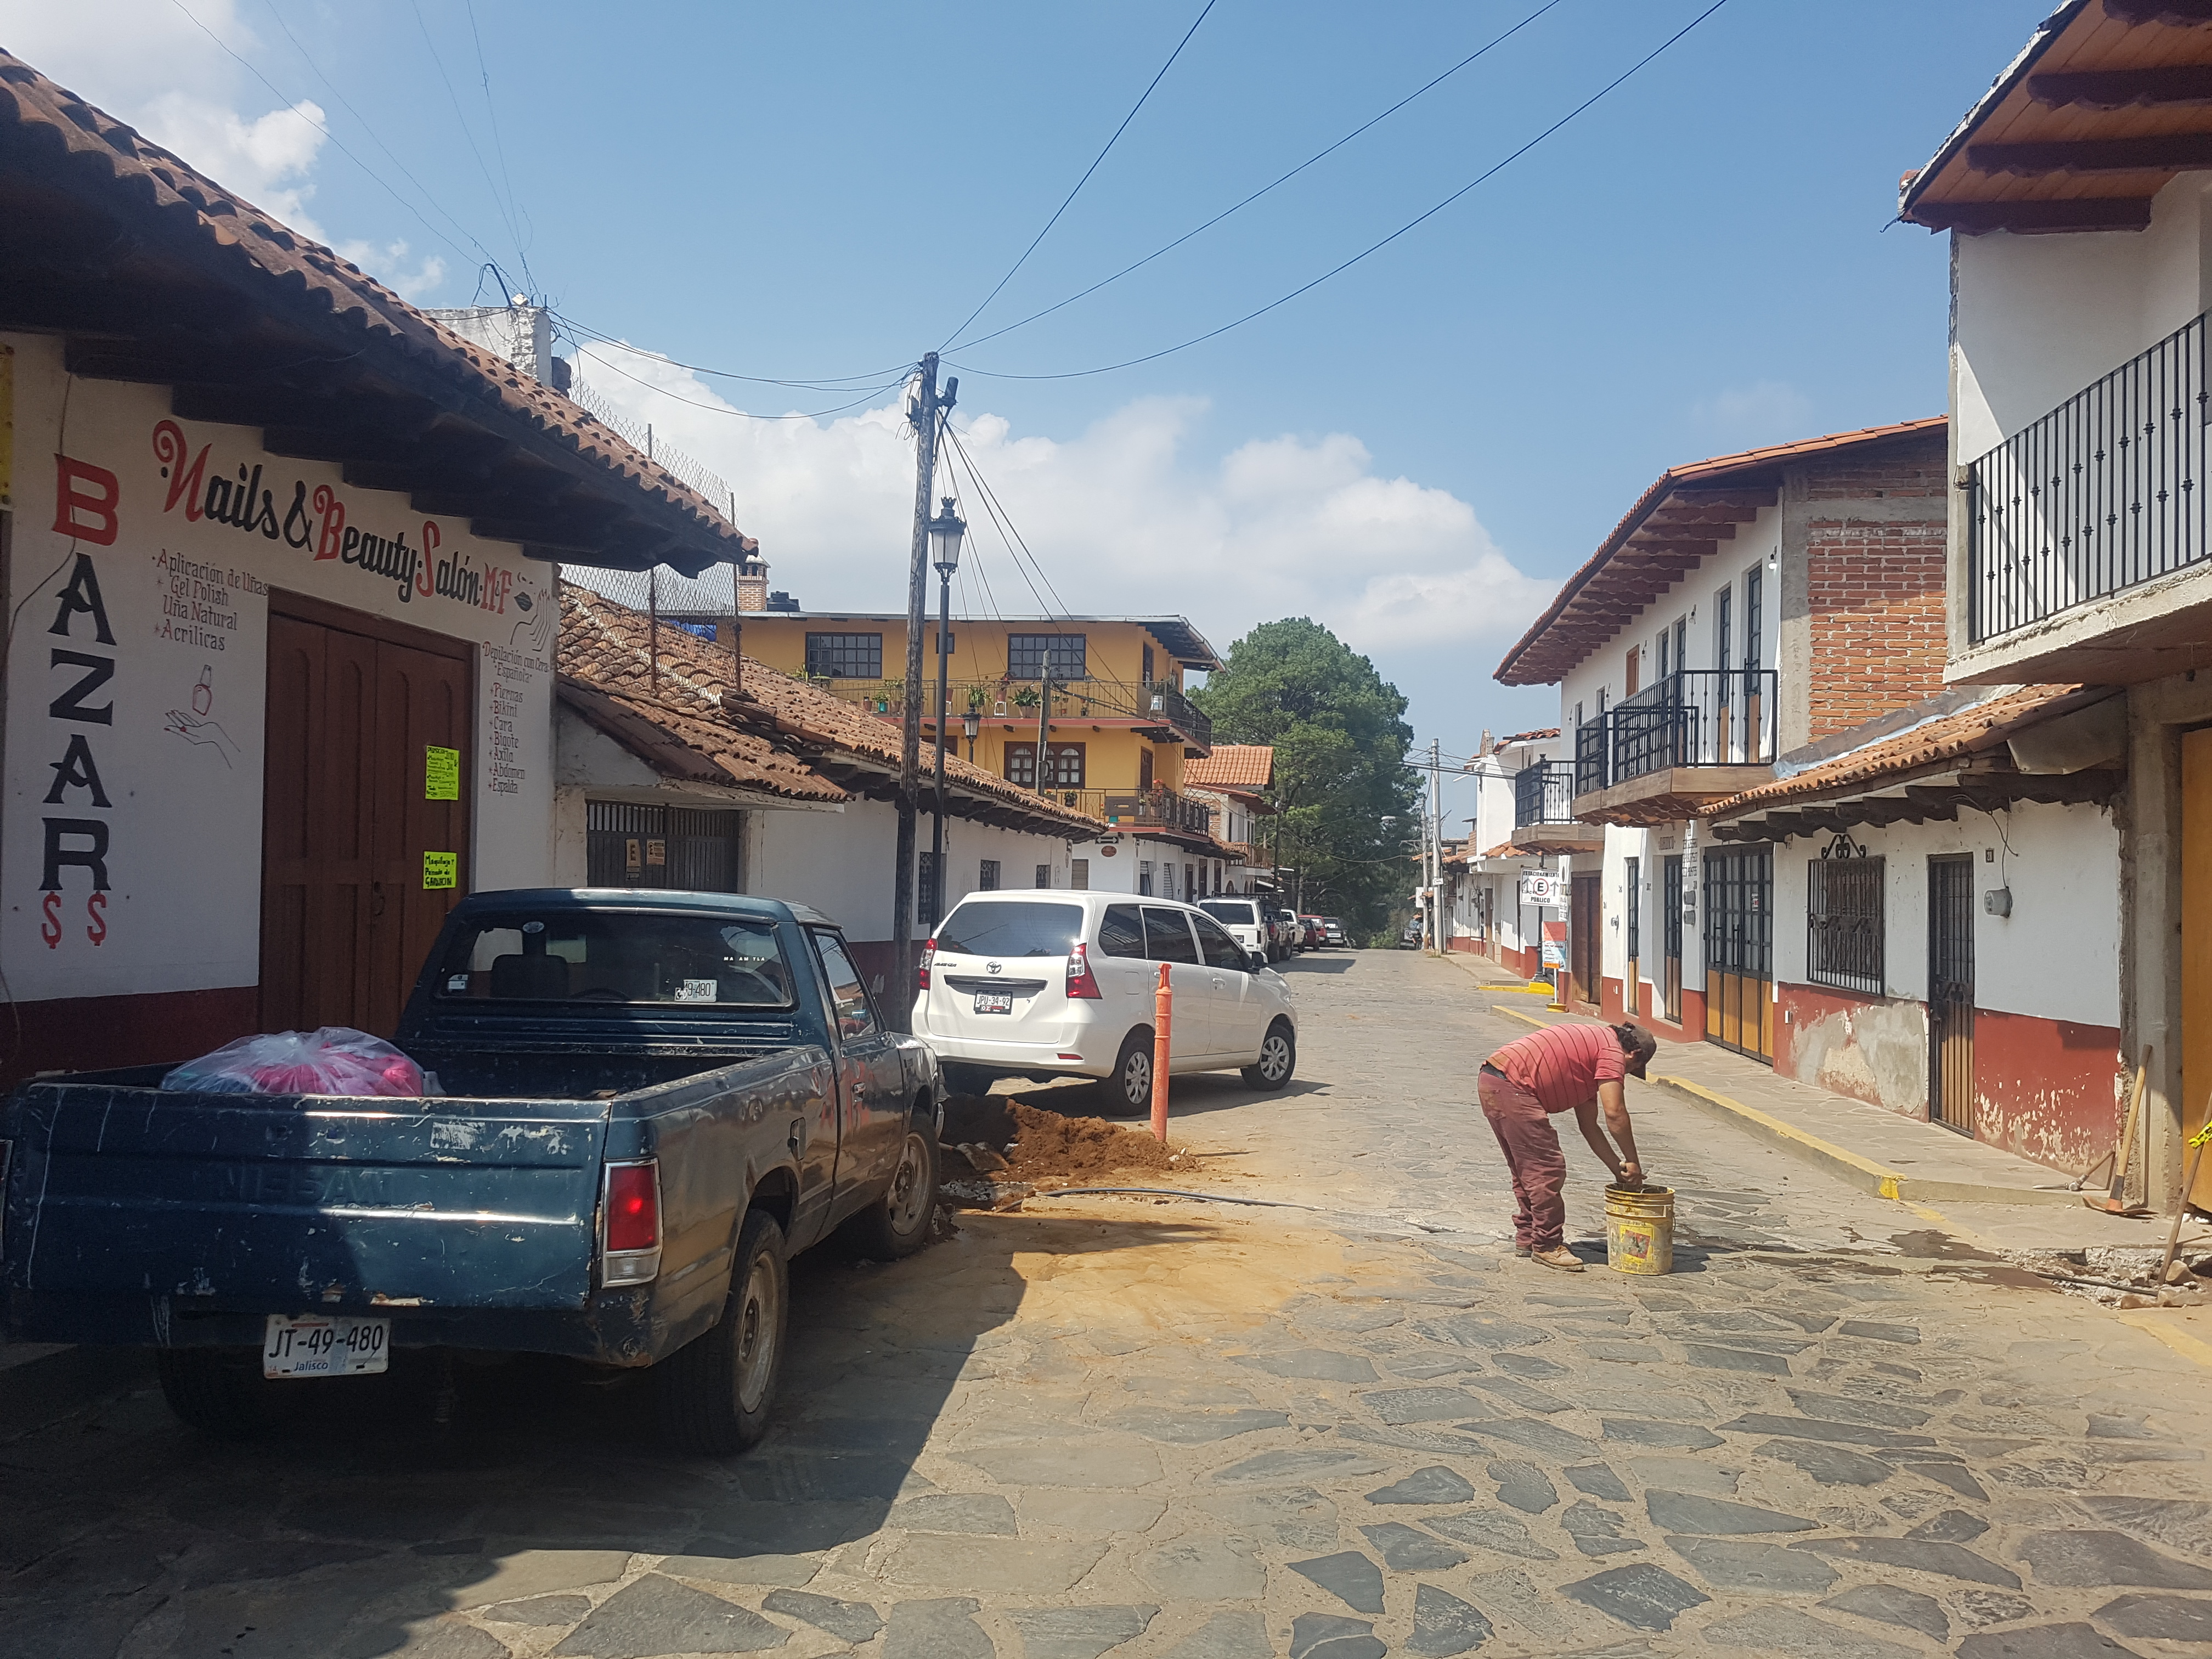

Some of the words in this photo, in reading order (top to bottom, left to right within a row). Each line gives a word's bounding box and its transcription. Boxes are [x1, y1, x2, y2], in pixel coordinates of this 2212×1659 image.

[152, 420, 280, 540] Nails
[283, 480, 313, 552] &
[313, 484, 417, 603] Beauty
[156, 549, 224, 585] Aplicación
[227, 568, 240, 589] de
[242, 572, 269, 596] Uñas
[171, 575, 189, 599] Gel
[193, 579, 228, 606] Polish
[163, 594, 188, 619] Uña
[191, 601, 237, 630] Natural
[160, 619, 225, 651] Acrilicas
[483, 641, 522, 666] Depilación
[524, 657, 534, 670] con
[38, 453, 119, 891] BAZAR
[496, 662, 529, 683] Española
[493, 682, 523, 703] Piernas
[493, 700, 517, 718] Bikini
[494, 716, 512, 732] Cara
[494, 731, 518, 748] Bigote
[494, 746, 514, 763] Axila
[493, 762, 525, 780] Abdomen
[1537, 882, 1544, 891] E
[977, 995, 1010, 1006] JPU-34-92
[268, 1324, 383, 1358] JT-49-480
[294, 1361, 329, 1372] Jalisco
